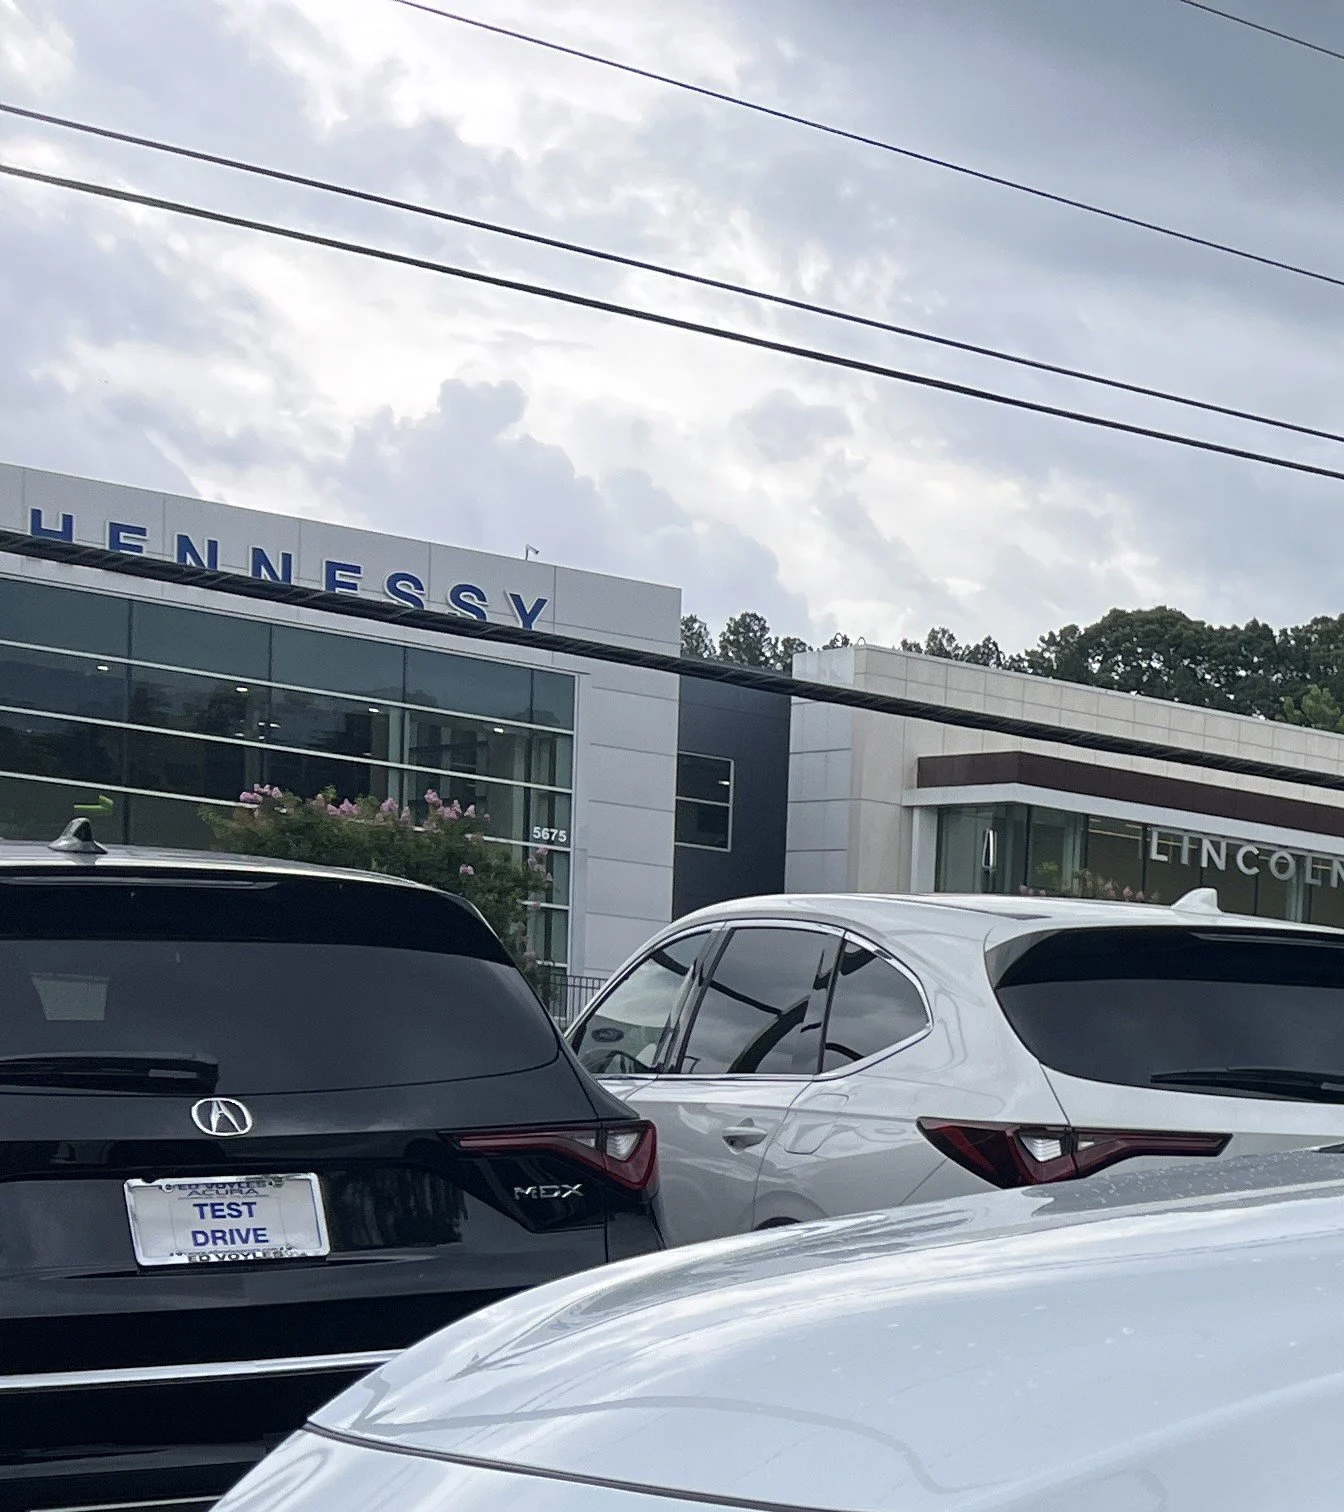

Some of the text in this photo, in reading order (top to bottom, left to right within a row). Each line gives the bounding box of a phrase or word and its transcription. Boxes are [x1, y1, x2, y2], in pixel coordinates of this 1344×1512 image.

[533, 826, 567, 842] 5675
[187, 1188, 260, 1197] ACURA
[513, 1183, 585, 1200] MDX
[193, 1202, 257, 1219] TEST
[191, 1228, 269, 1247] DRIVE
